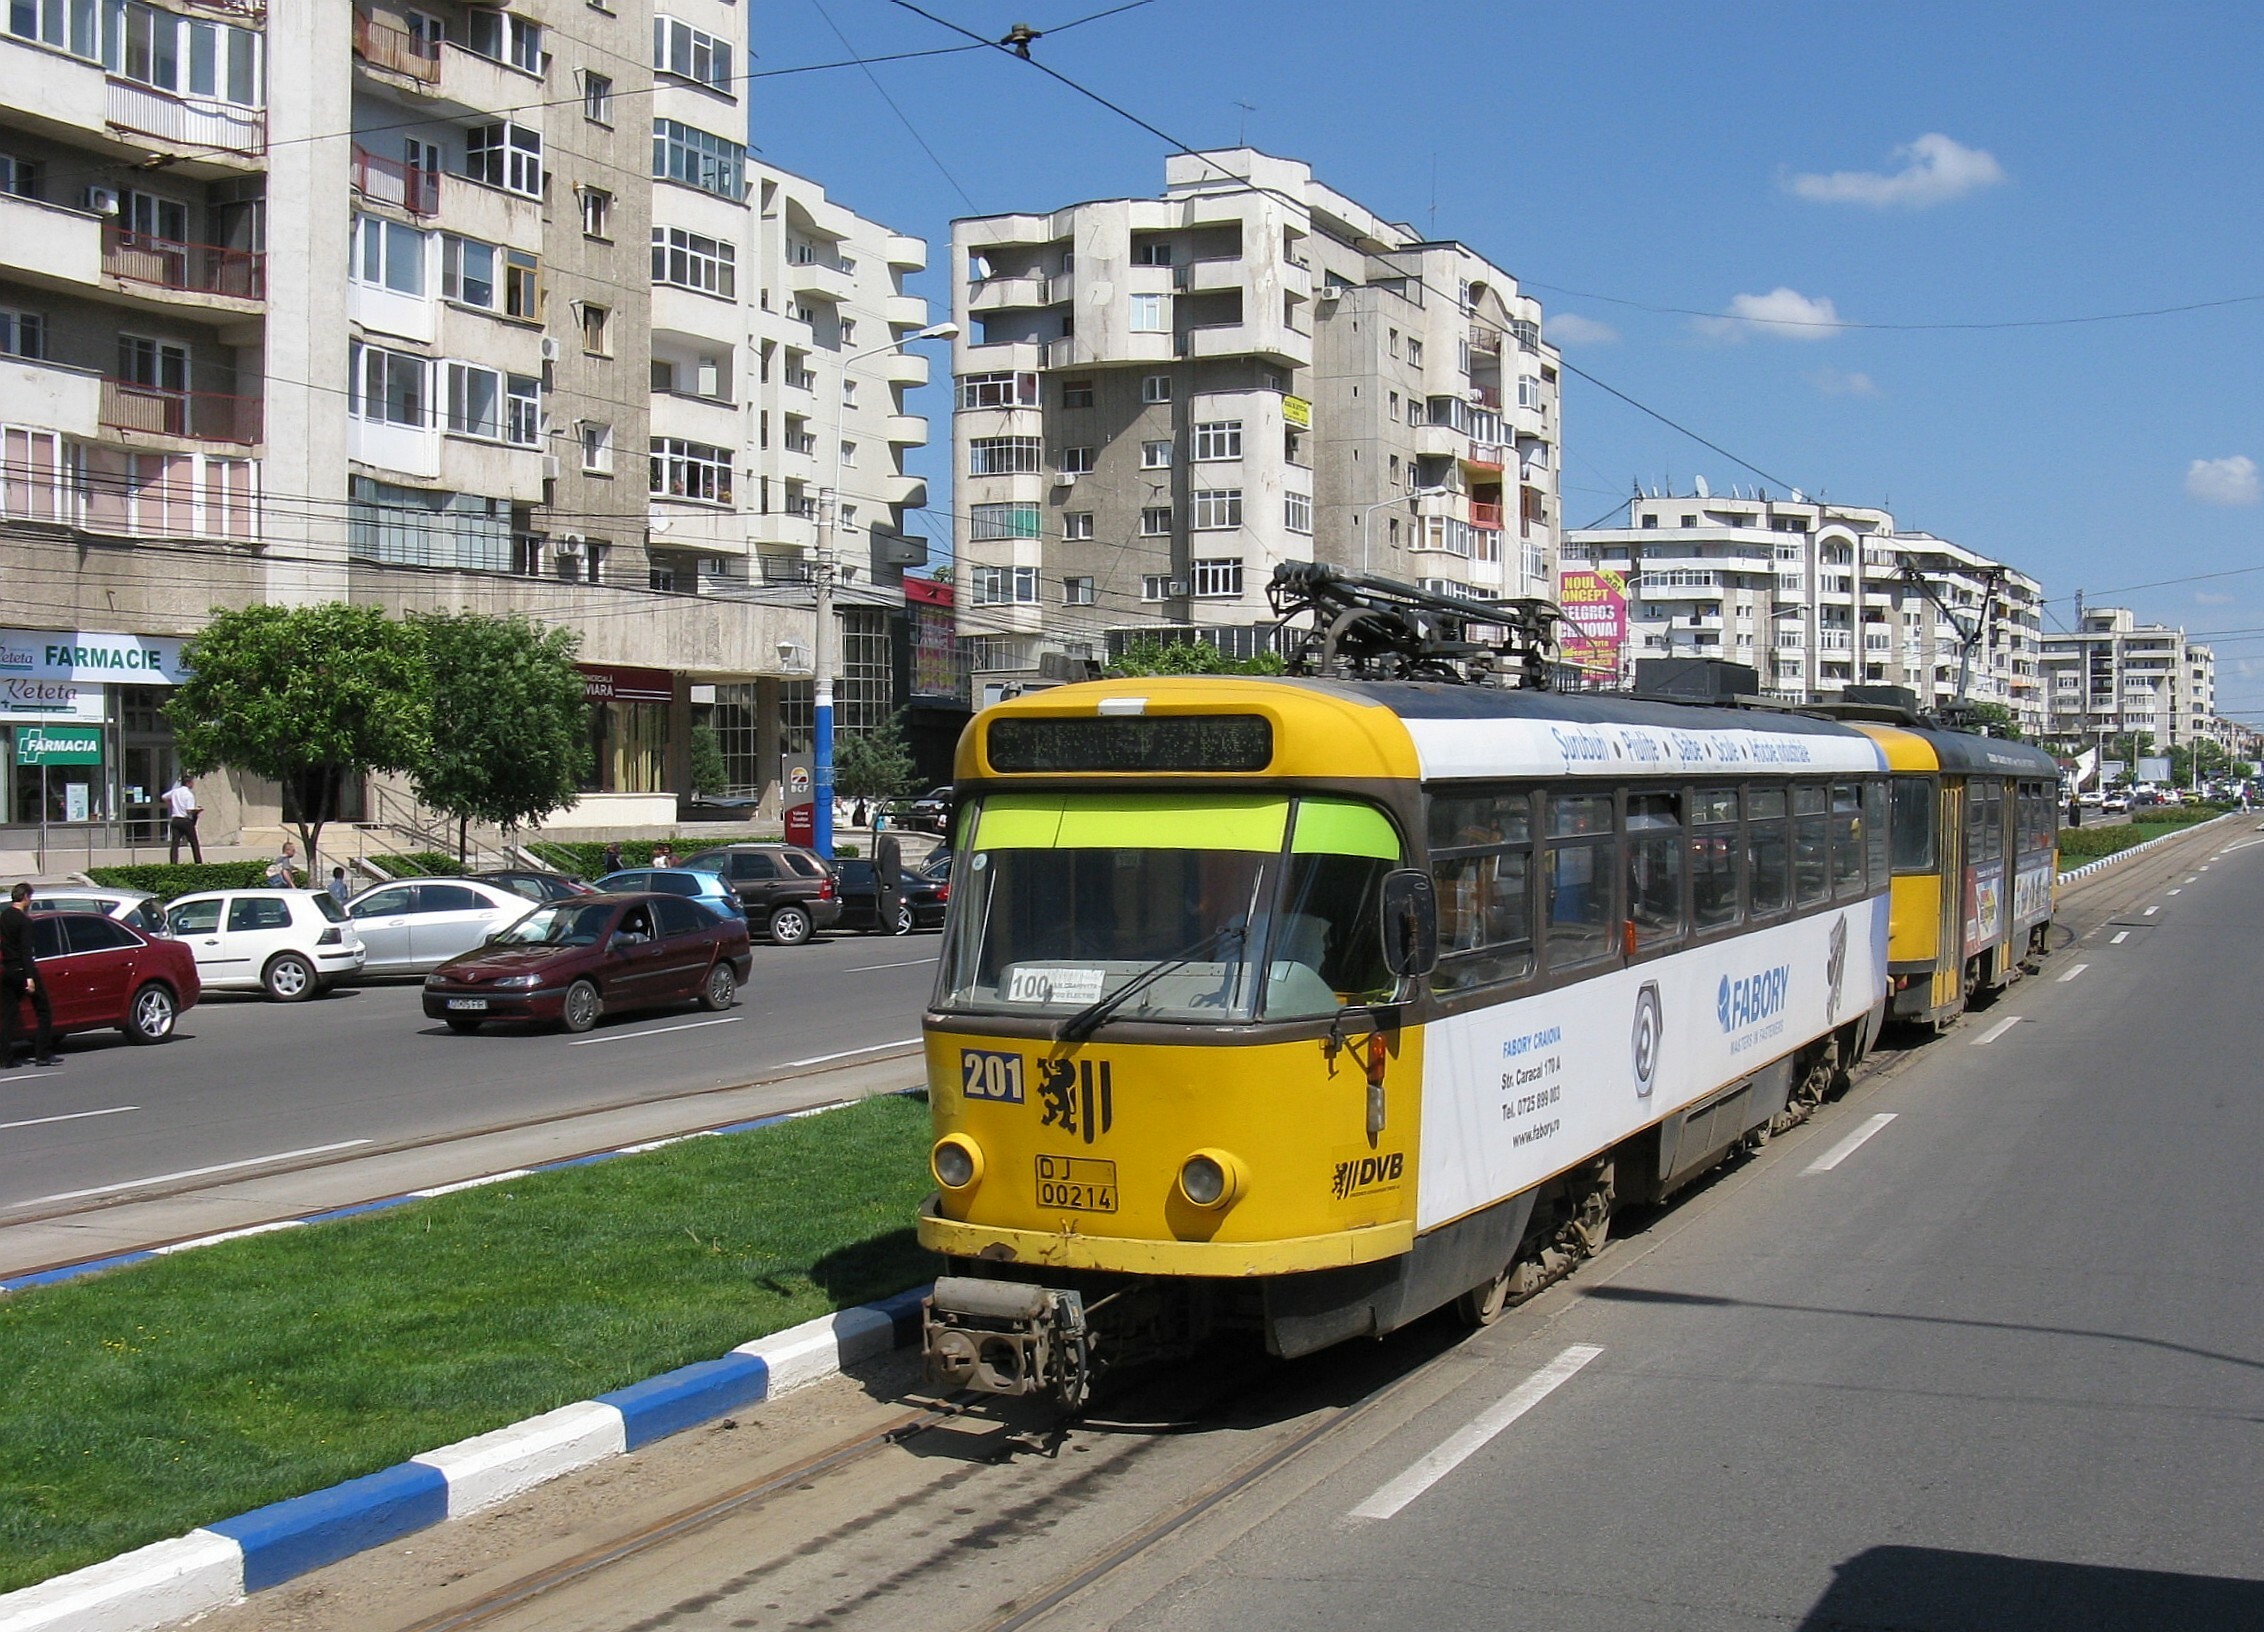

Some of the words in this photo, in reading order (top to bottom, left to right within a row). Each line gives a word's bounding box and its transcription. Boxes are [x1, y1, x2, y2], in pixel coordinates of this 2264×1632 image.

[1561, 589, 1609, 602] ONCEPT
[1564, 576, 1597, 589] NOUL
[45, 644, 161, 670] FARMACIE
[584, 683, 614, 696] VIARA
[27, 739, 97, 752] FARMACIA
[790, 784, 809, 793] BCF
[1012, 974, 1049, 998] 100
[1731, 963, 1790, 1031] FABORY
[1503, 1034, 1533, 1058] FABORY
[1534, 1026, 1562, 1049] CRAIOVA
[964, 1053, 1022, 1099] 201
[1501, 1072, 1514, 1090] Str.
[1516, 1061, 1543, 1085] Caracal
[1502, 1101, 1516, 1121] Tel.
[1517, 1095, 1536, 1116] 0725
[1512, 1118, 1561, 1149] www.fabory.ro
[1359, 1152, 1404, 1186] DVB
[1042, 1183, 1111, 1209] 00214
